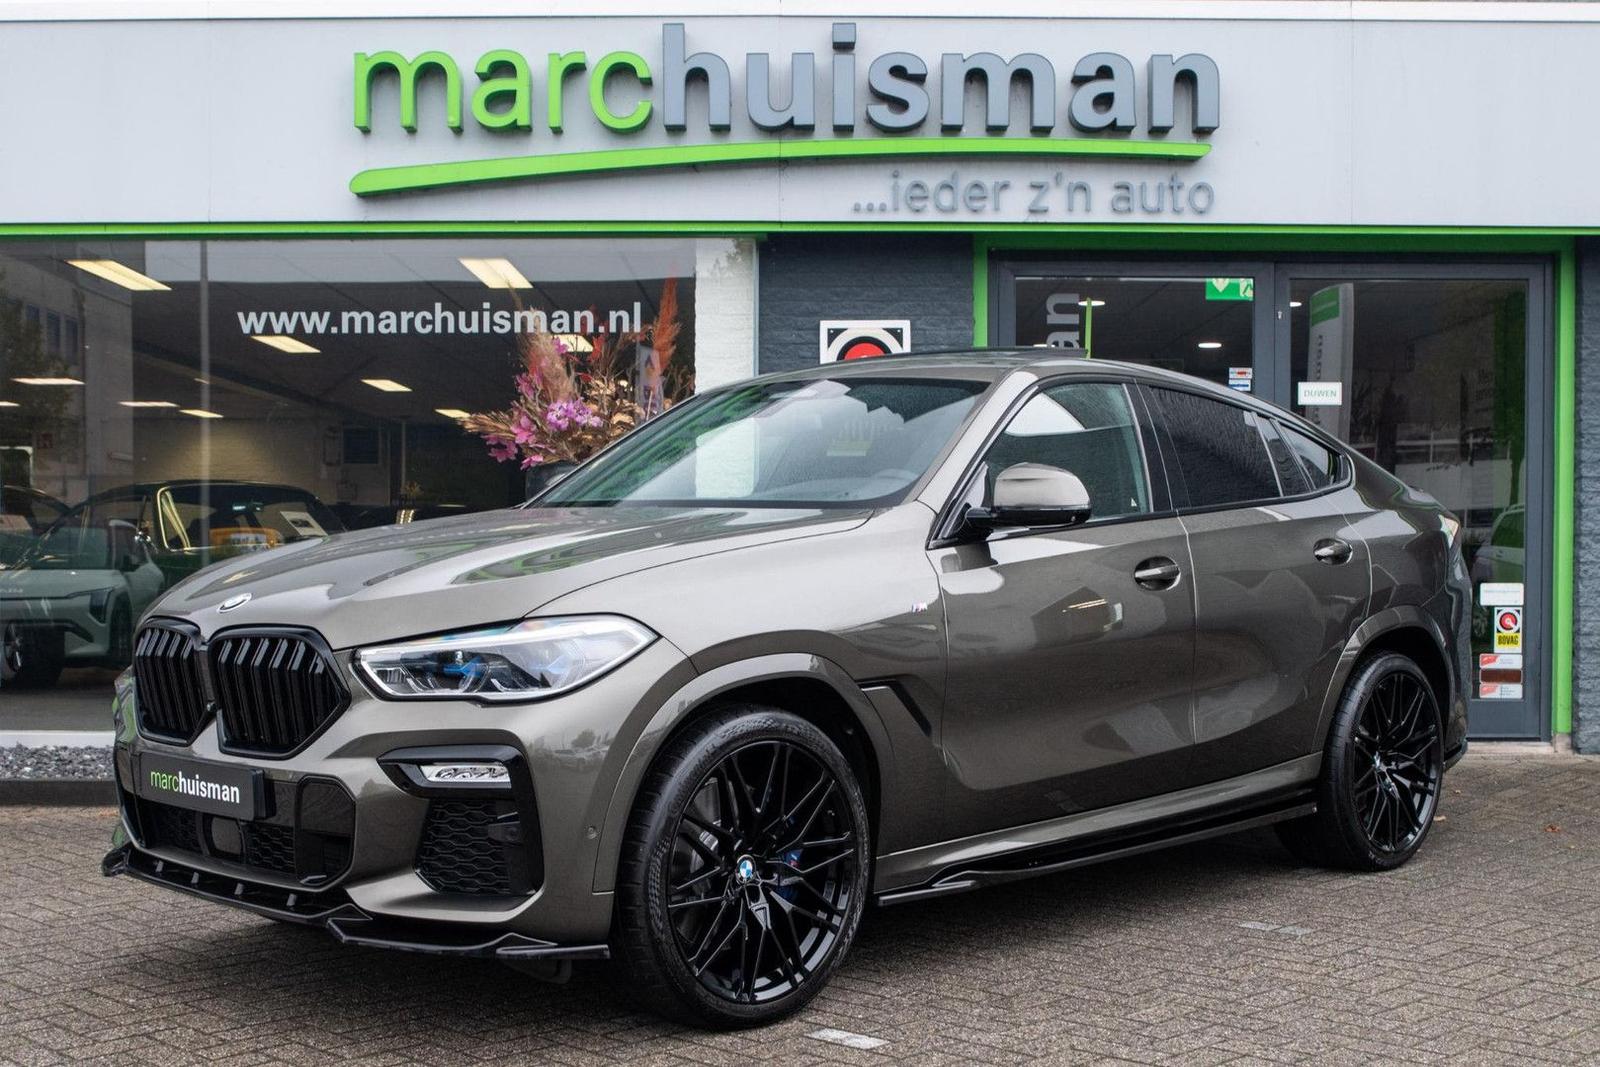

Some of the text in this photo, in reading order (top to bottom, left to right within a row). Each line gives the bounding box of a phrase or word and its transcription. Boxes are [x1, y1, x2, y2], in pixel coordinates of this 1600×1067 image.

[353, 23, 1221, 133] marchuisman
[1027, 171, 1091, 213] z'n
[1110, 172, 1214, 214] auto
[237, 302, 641, 335] www.marchuisman.nl
[1497, 634, 1519, 646] BOVAG
[150, 771, 240, 804] marchuisman
